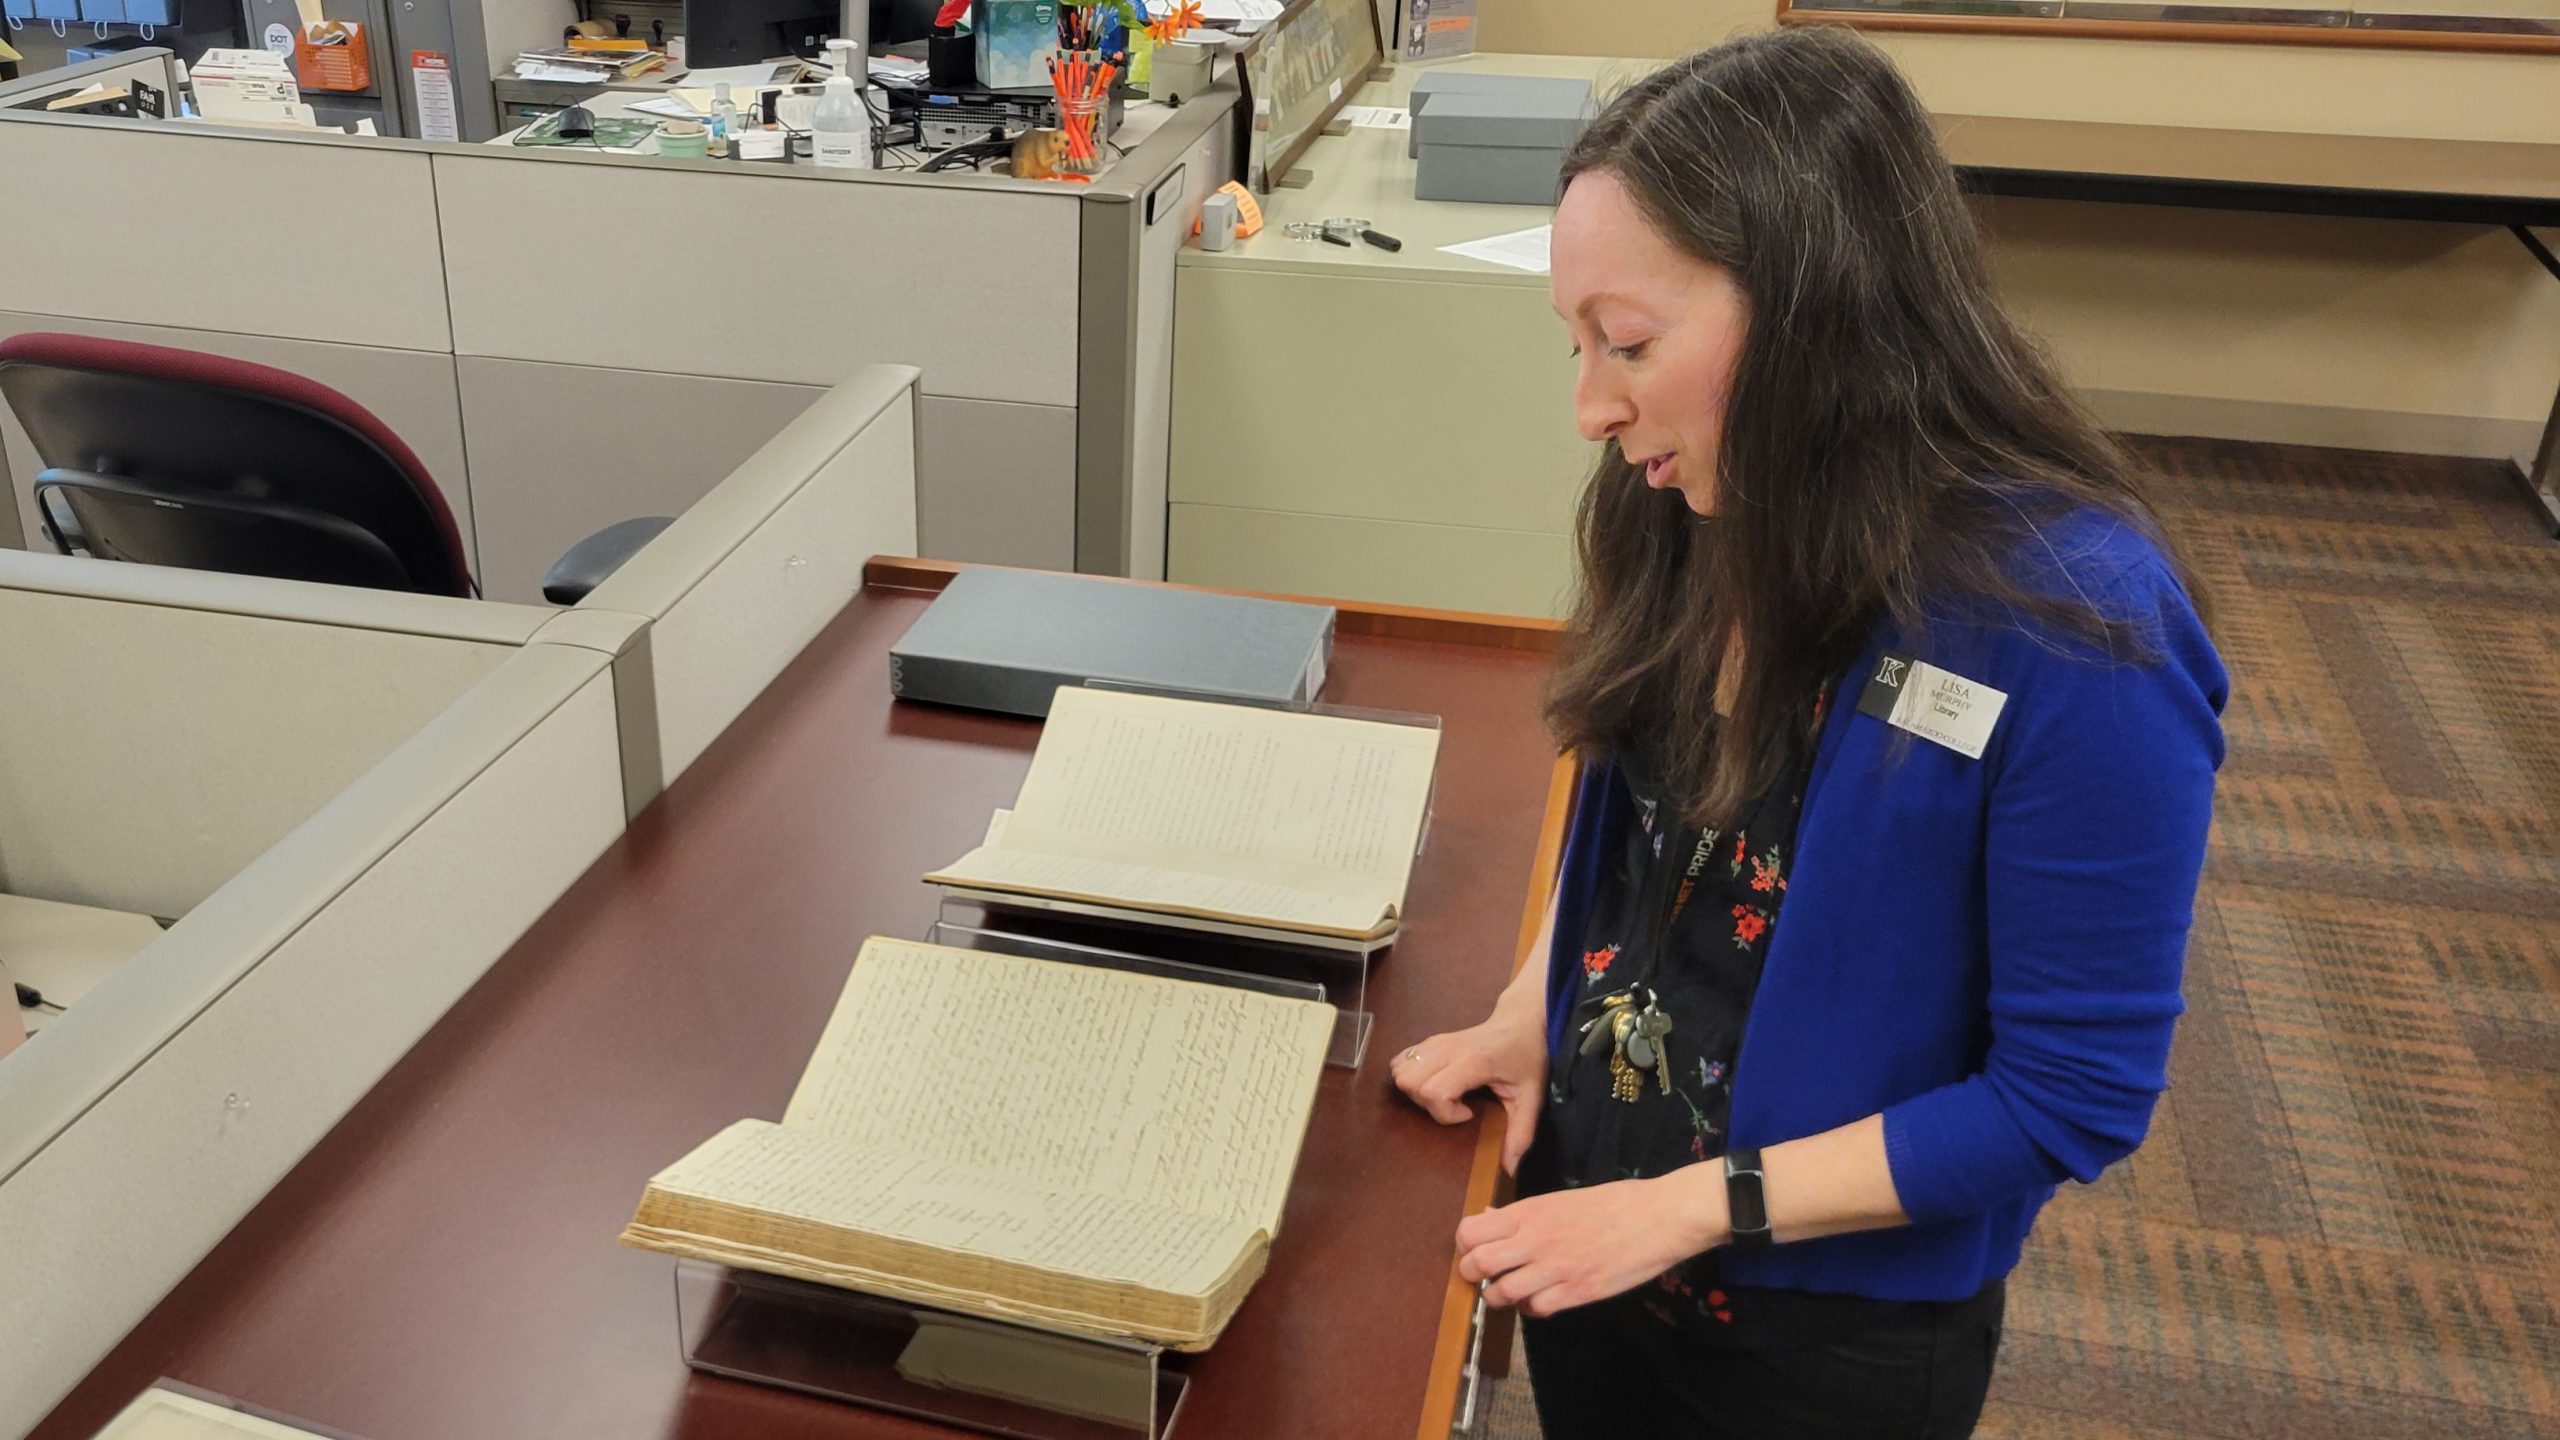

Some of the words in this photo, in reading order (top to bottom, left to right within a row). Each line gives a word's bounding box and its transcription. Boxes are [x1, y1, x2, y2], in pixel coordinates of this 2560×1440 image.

[1875, 656, 1905, 687] K
[1930, 689, 1973, 711] MURPHY
[1941, 678, 1970, 700] LISA
[1933, 702, 1960, 720] Library
[1687, 826, 1719, 876] PRIDE
